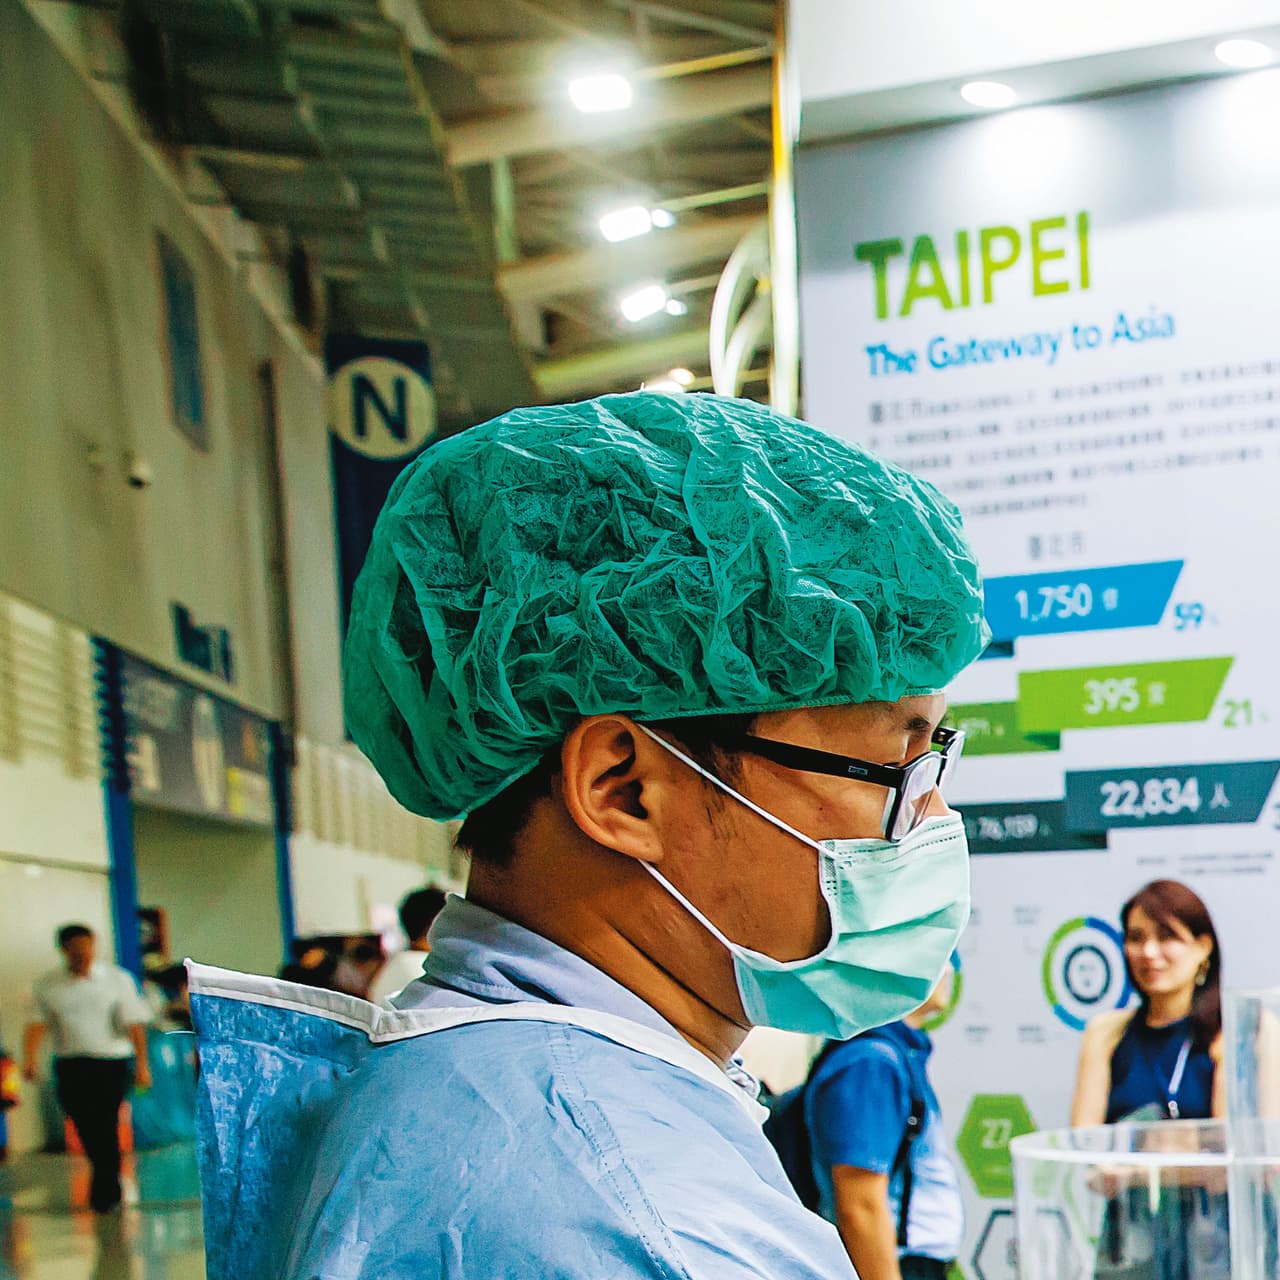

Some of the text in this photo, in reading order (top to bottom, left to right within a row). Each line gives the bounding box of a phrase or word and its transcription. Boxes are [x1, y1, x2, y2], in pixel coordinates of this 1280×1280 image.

[853, 210, 1090, 321] TAIPEI
[865, 305, 1176, 377] The Gateway to Asia
[352, 373, 408, 440] N
[1014, 582, 1093, 622] 1,750
[1083, 677, 1140, 715] 395
[1100, 777, 1202, 819] 22,834
